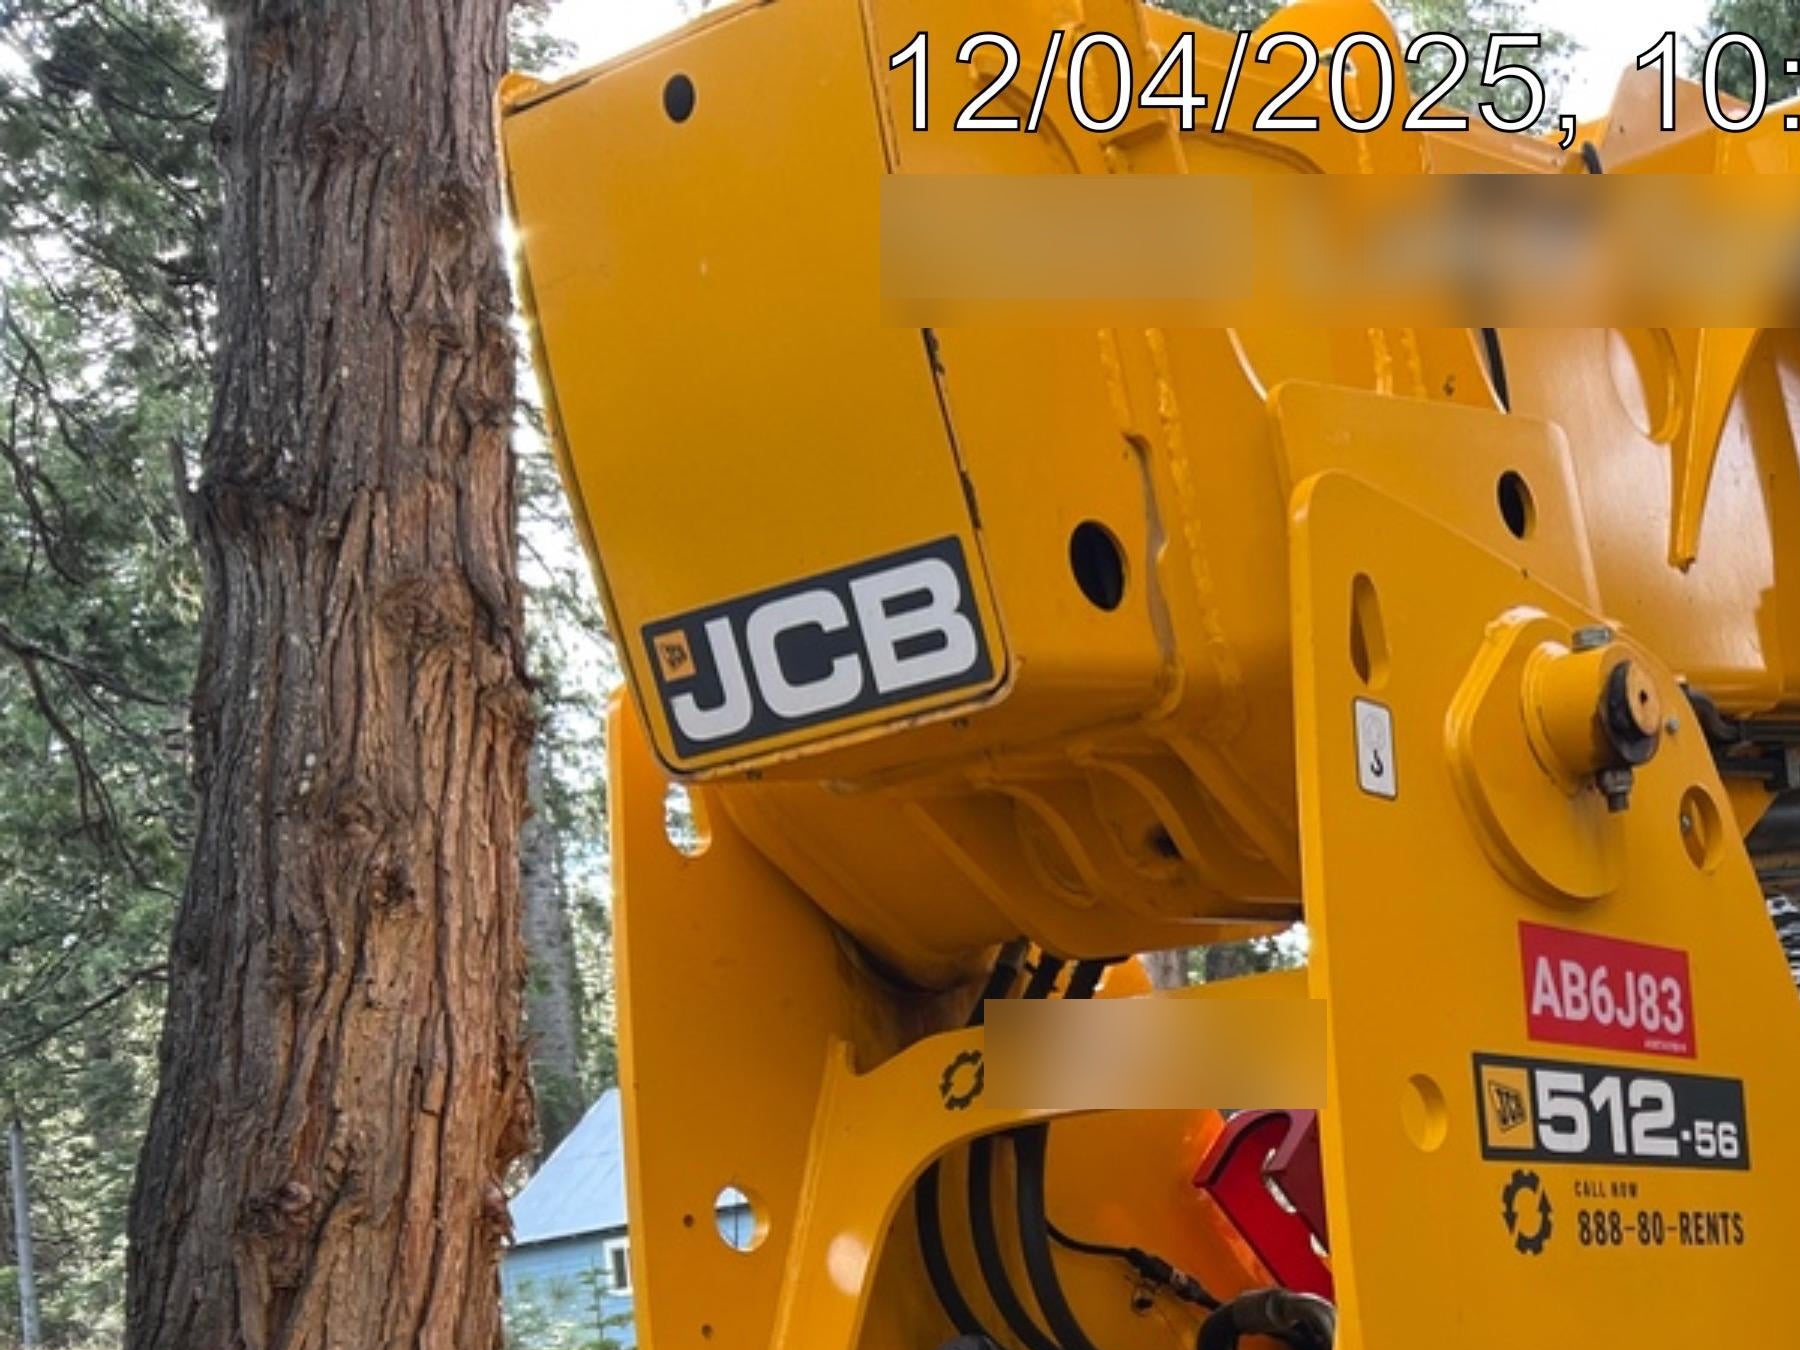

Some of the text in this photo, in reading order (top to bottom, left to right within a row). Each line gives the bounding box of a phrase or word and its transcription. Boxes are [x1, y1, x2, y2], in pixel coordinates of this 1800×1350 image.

[669, 557, 979, 742] JCB
[1531, 956, 1685, 1035] AB6J83
[1574, 1181, 1638, 1198] CALL NOW
[1577, 1209, 1745, 1246] 888-80-RENTS
